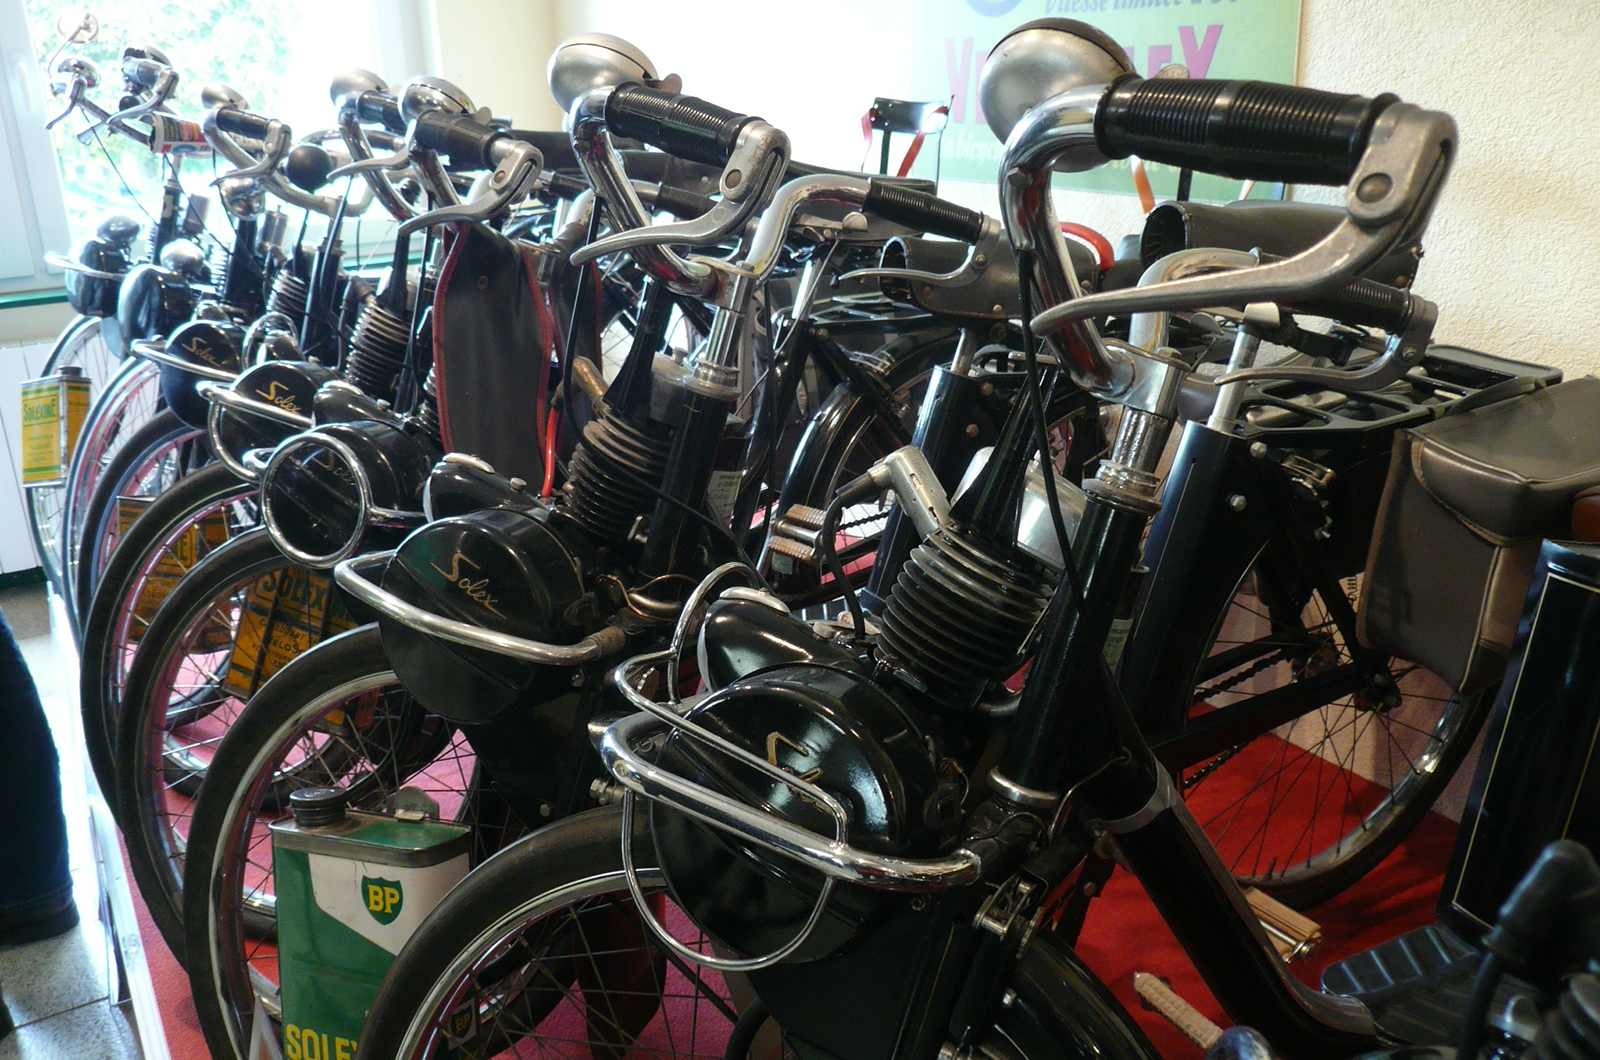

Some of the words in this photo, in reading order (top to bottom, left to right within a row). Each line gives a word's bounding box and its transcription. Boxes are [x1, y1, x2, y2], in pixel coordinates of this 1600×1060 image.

[182, 337, 220, 367] Solex
[255, 381, 301, 415] Solex
[430, 552, 507, 620] Solex
[367, 884, 400, 914] BP
[455, 1012, 471, 1034] BP
